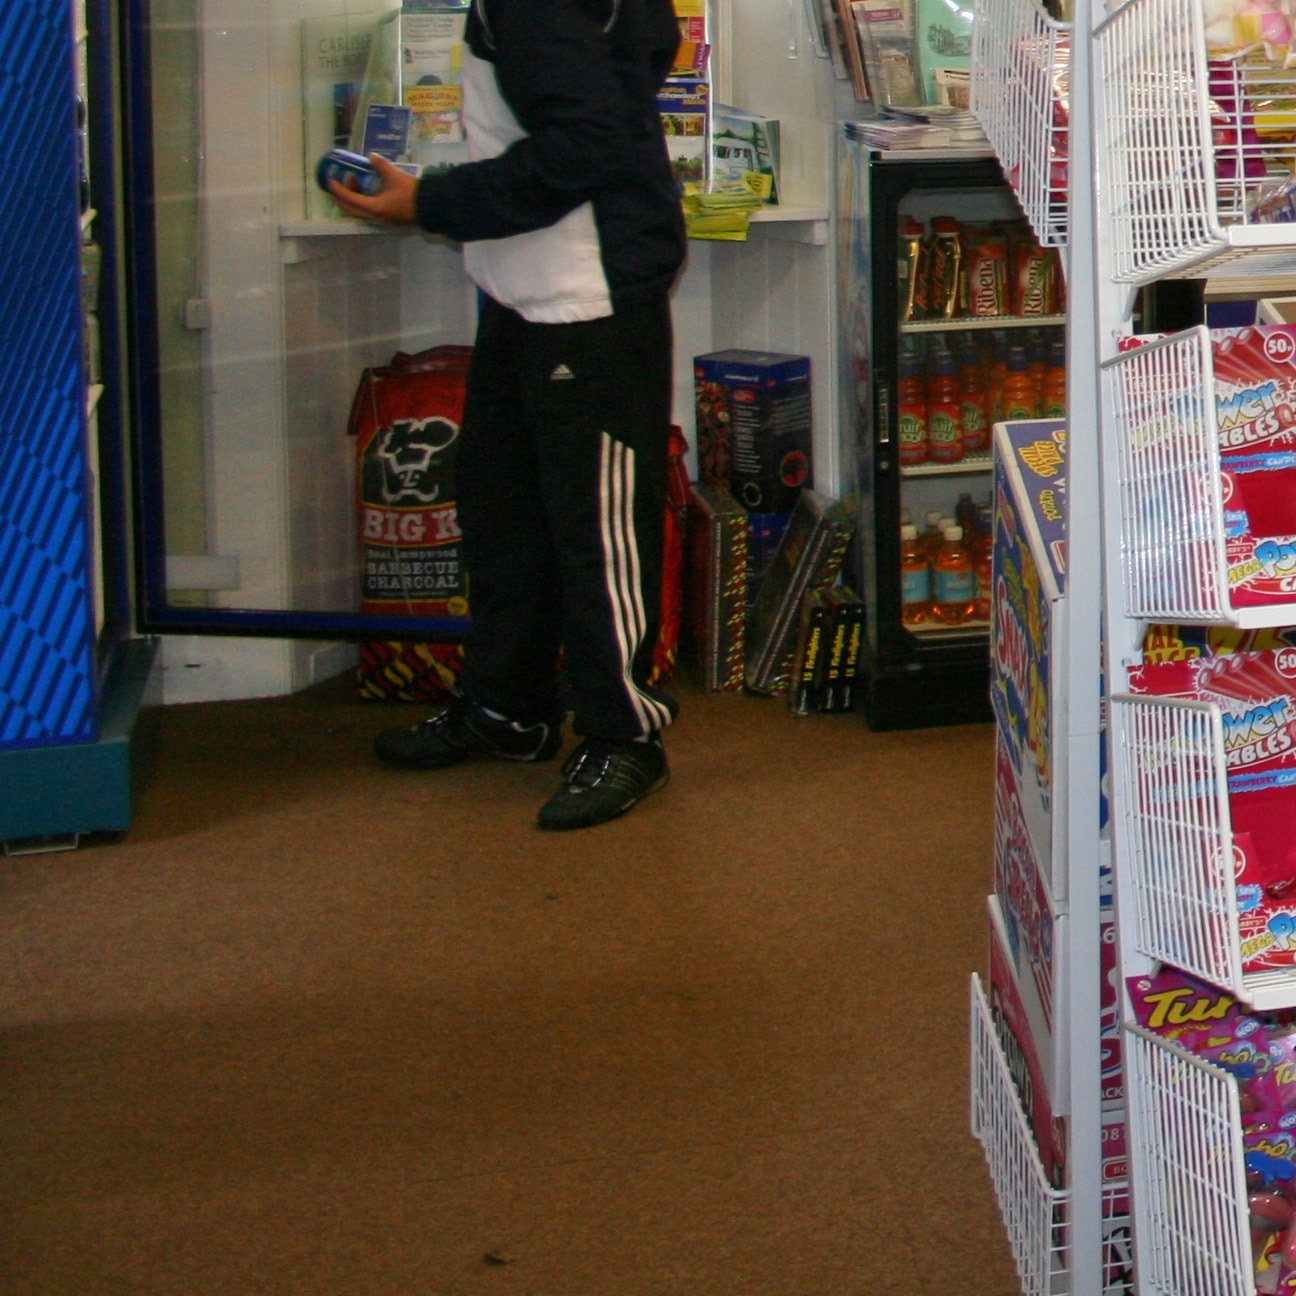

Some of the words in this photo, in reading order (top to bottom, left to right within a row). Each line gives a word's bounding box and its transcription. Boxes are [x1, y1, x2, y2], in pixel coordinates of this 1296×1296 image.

[362, 508, 426, 543] BIG
[431, 507, 463, 540] K
[367, 561, 459, 575] BARBECUE
[367, 575, 460, 589] CHARCOAL
